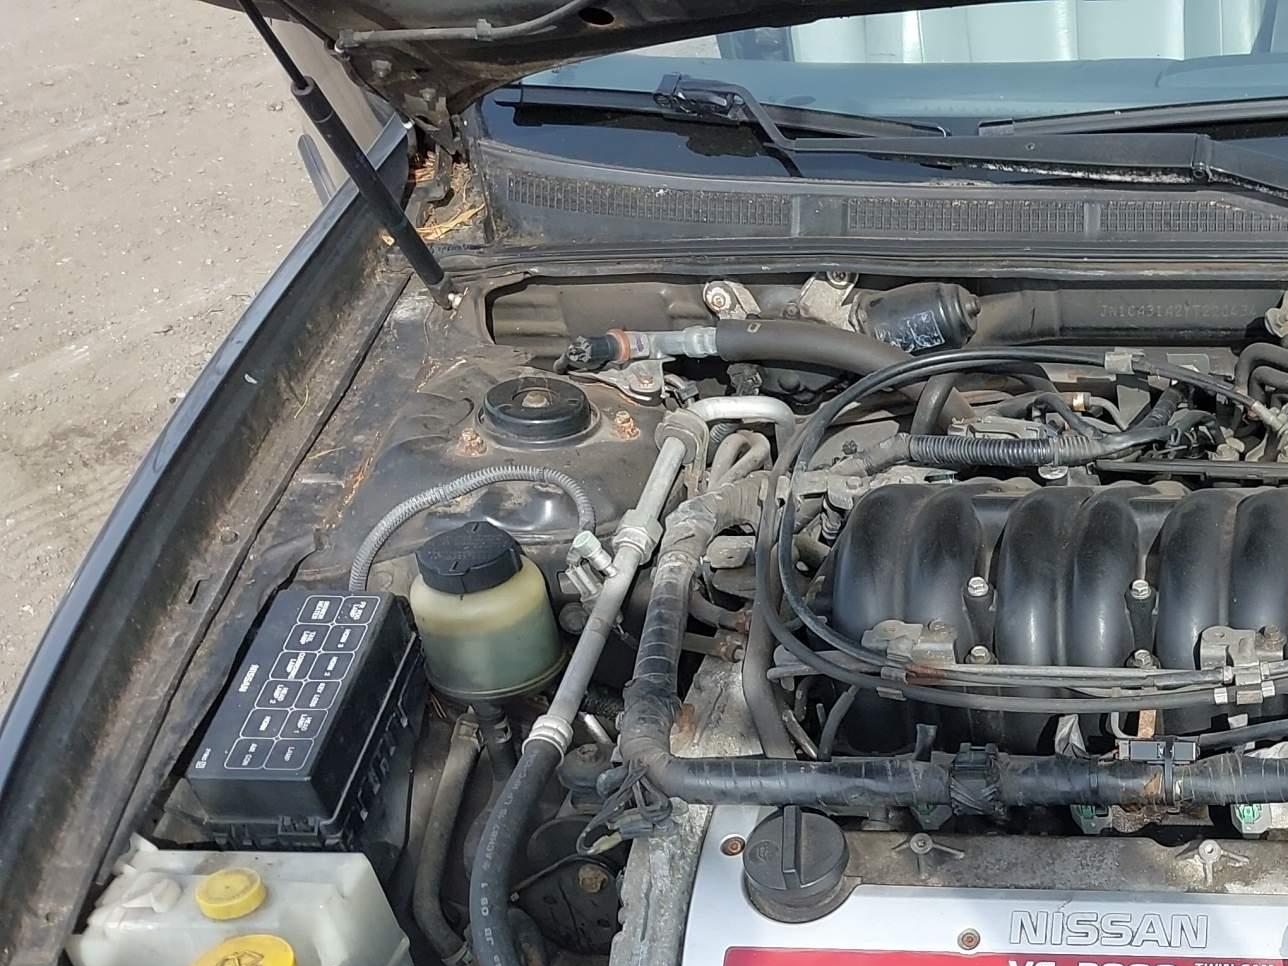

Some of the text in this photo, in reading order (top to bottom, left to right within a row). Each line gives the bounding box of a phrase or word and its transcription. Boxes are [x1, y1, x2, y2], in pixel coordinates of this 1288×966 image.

[239, 664, 259, 693] NISSAN
[284, 746, 295, 761] LAMP
[1009, 910, 1209, 949] NISSAN
